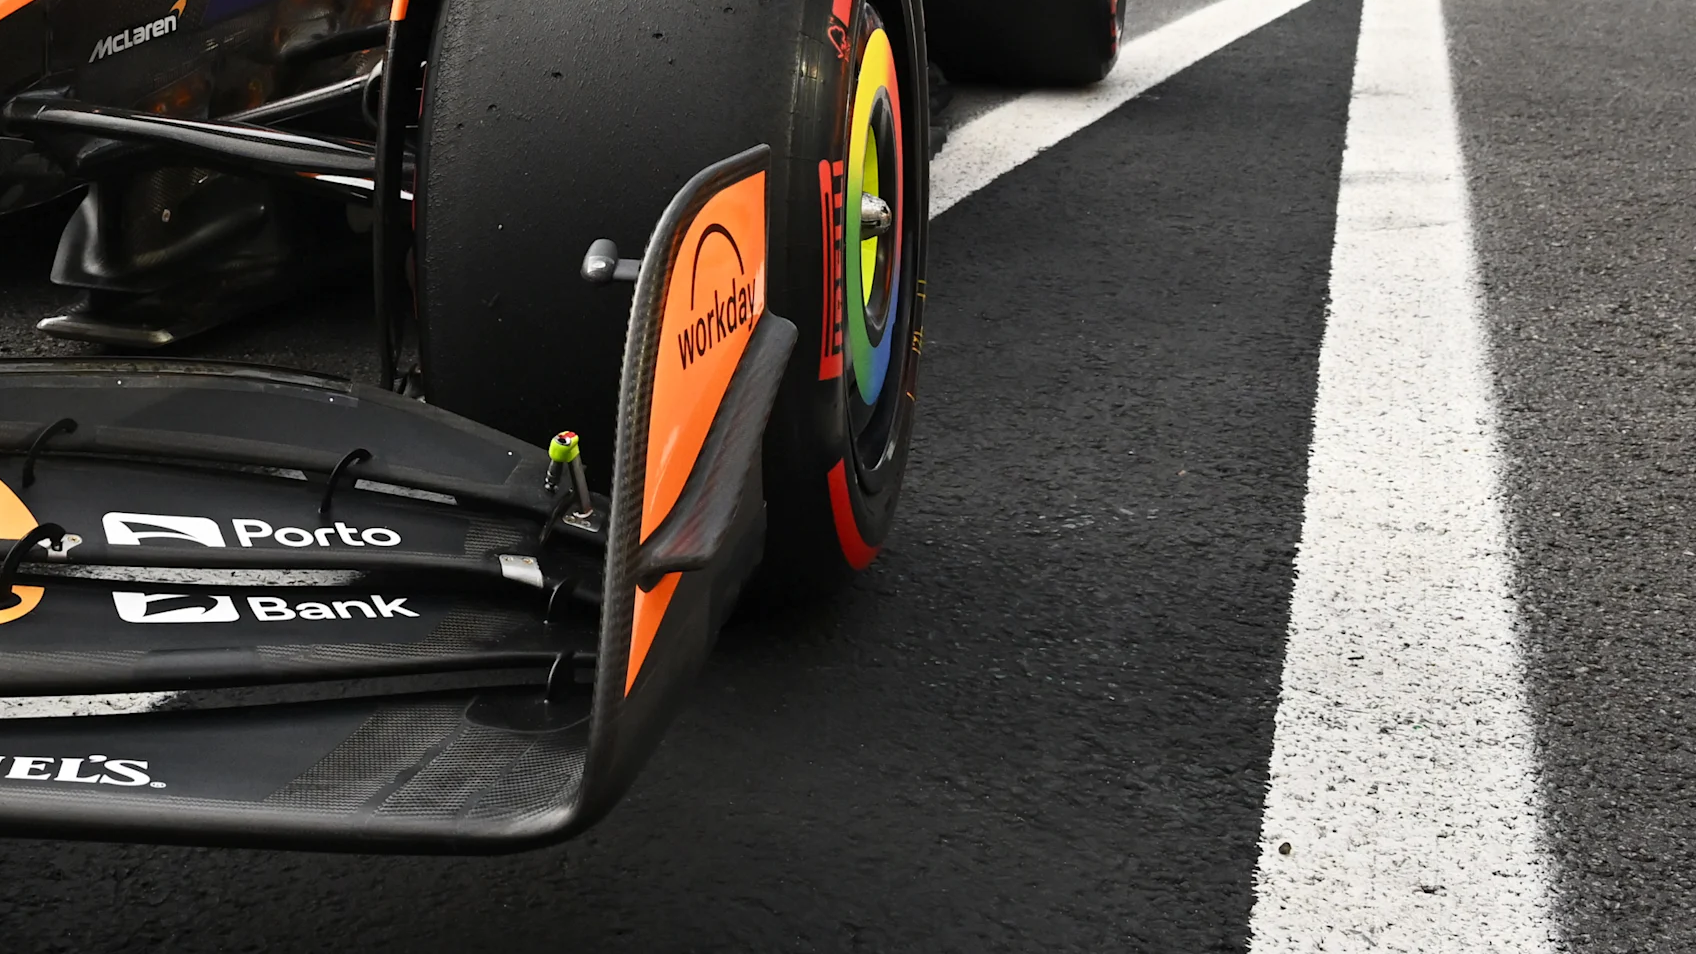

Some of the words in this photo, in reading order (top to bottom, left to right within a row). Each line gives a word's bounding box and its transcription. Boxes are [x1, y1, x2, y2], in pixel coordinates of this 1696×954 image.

[89, 14, 178, 64] McLaren
[677, 277, 756, 371] workday
[231, 518, 402, 547] Porto
[246, 594, 421, 623] Bank
